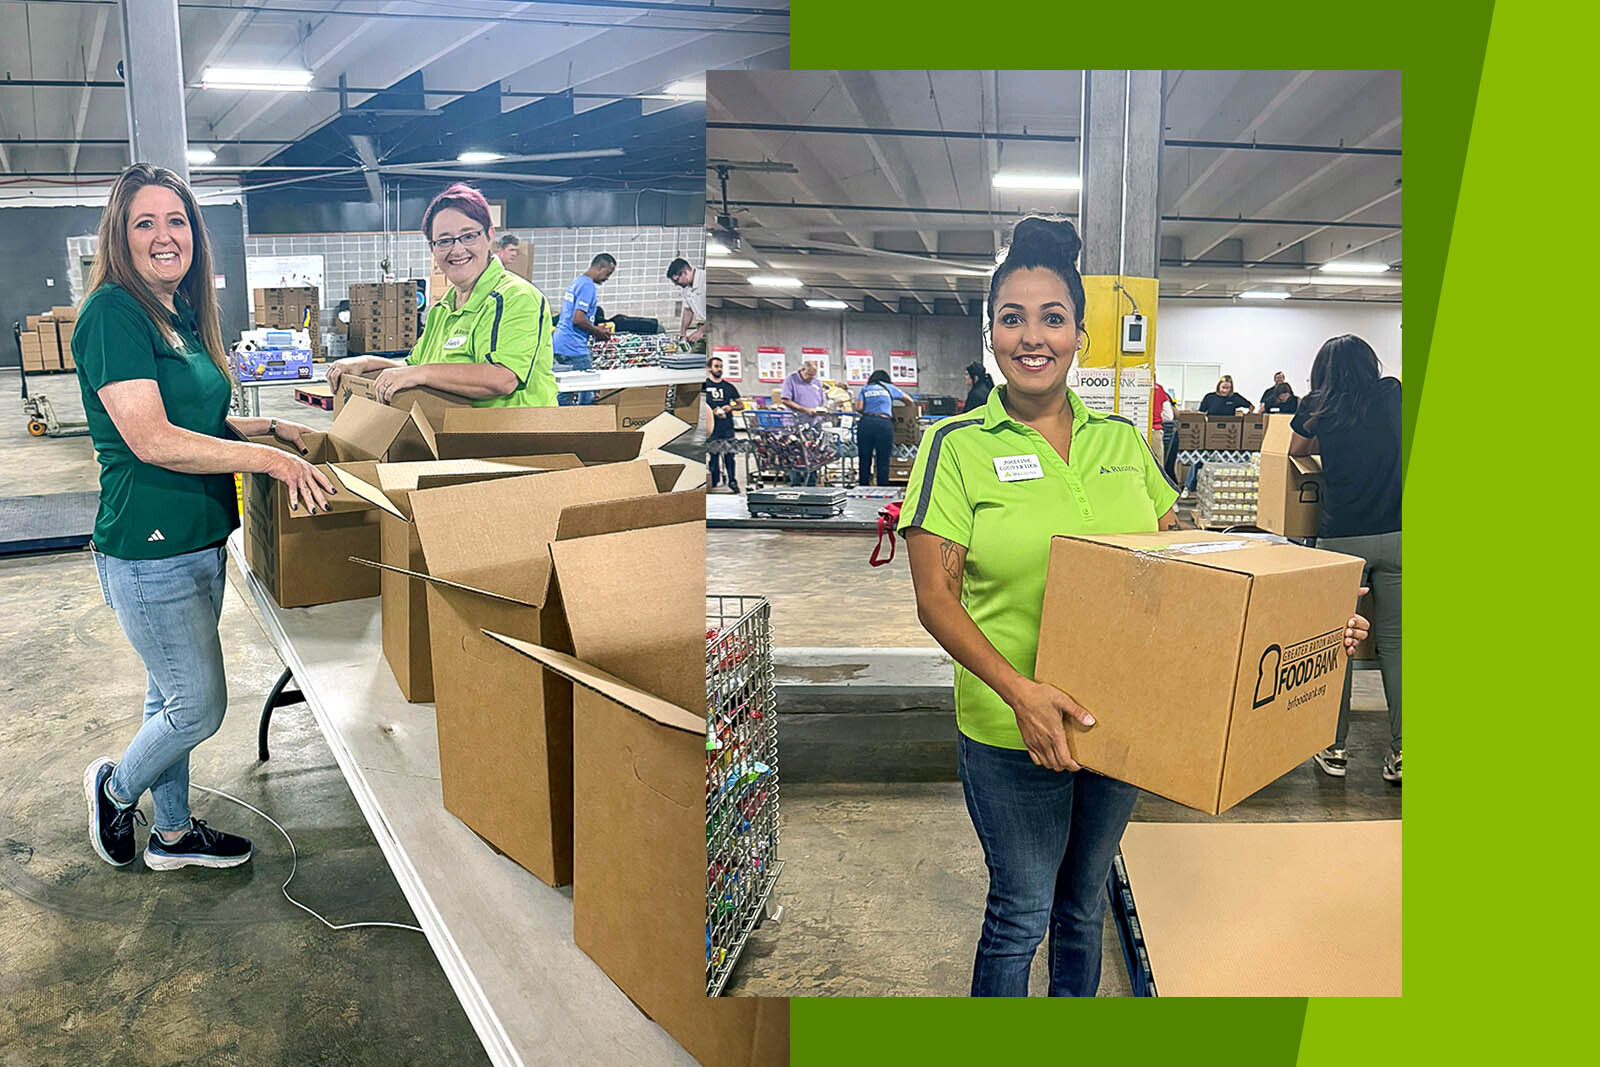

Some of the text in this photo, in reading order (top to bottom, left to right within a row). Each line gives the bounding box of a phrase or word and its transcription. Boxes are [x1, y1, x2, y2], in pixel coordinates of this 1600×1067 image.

[1081, 377, 1109, 387] FOOD
[1283, 644, 1308, 662] GREATER
[1309, 638, 1326, 653] BATON
[1278, 645, 1341, 696] FOOD BANK
